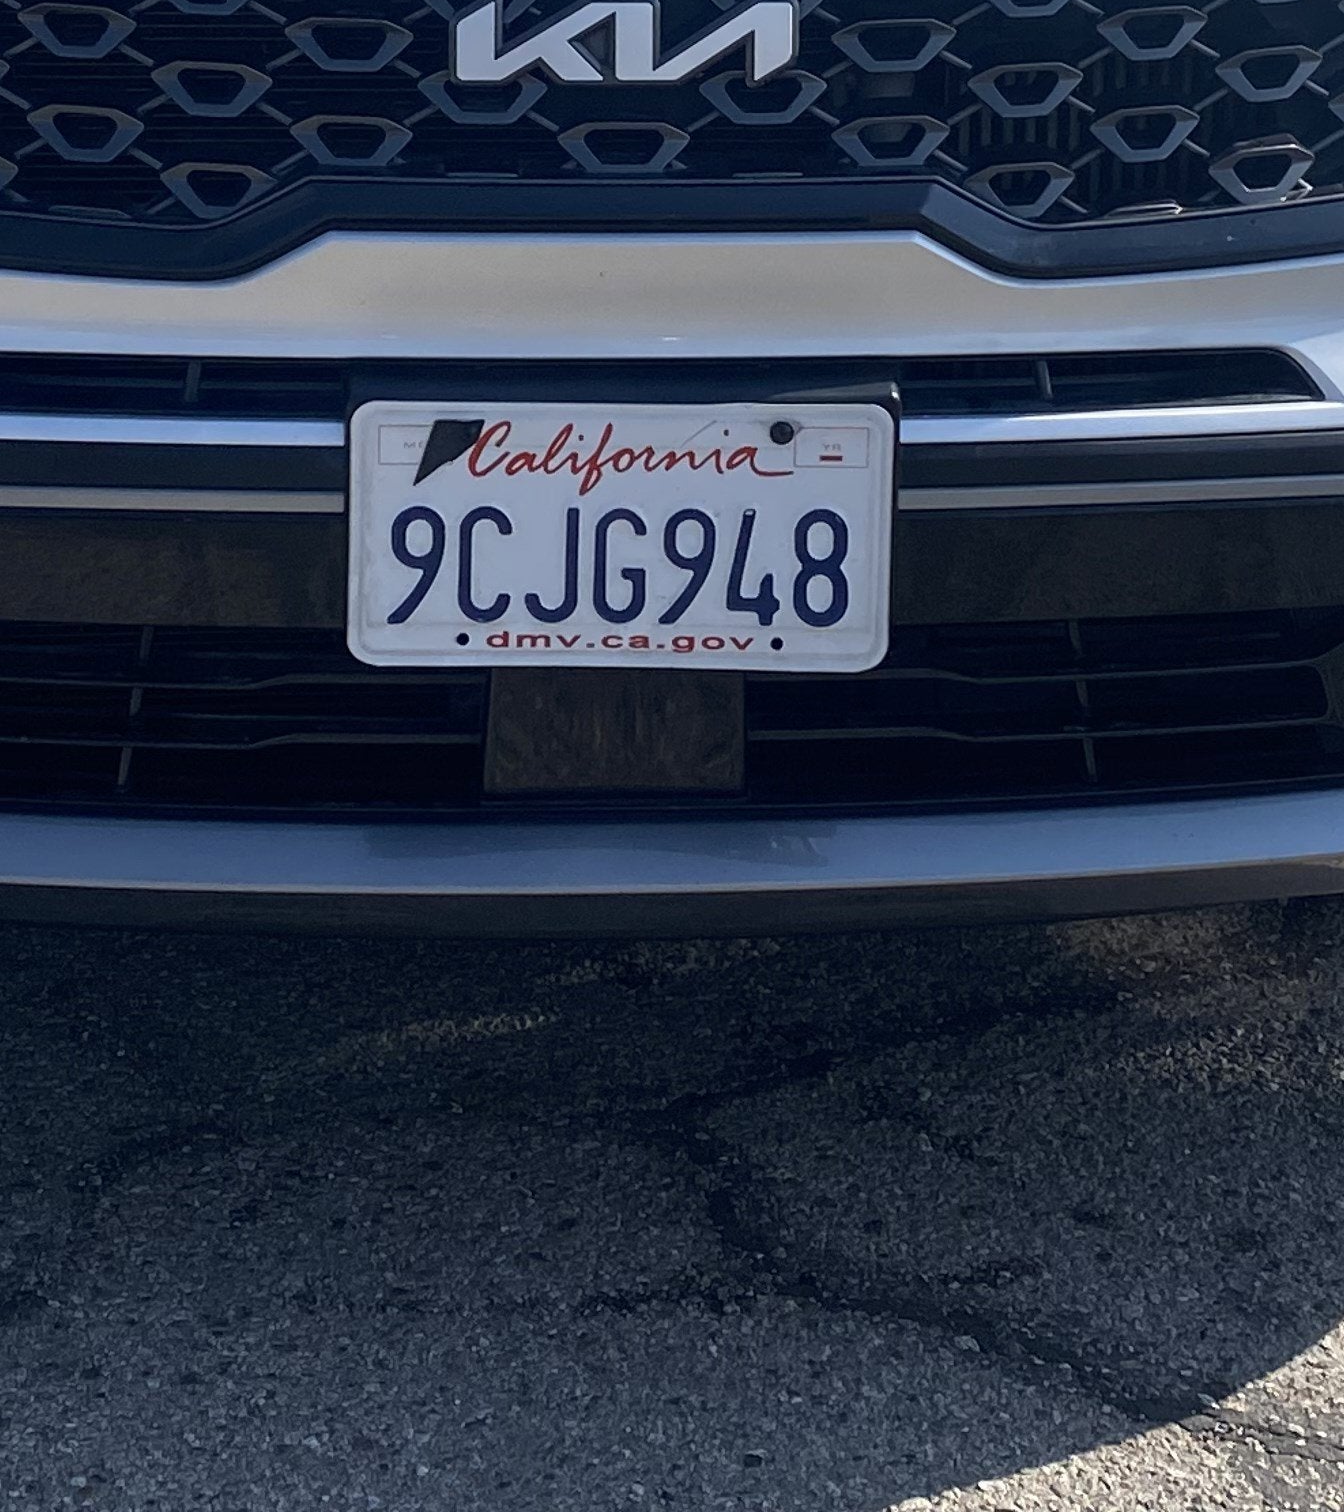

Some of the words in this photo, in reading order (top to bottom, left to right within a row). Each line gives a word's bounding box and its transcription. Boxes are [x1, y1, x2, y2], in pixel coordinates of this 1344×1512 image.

[456, 1, 793, 82] KIA
[467, 420, 794, 496] California
[386, 505, 850, 627] 9CJG948
[485, 630, 755, 654] dmv.ca.gov
